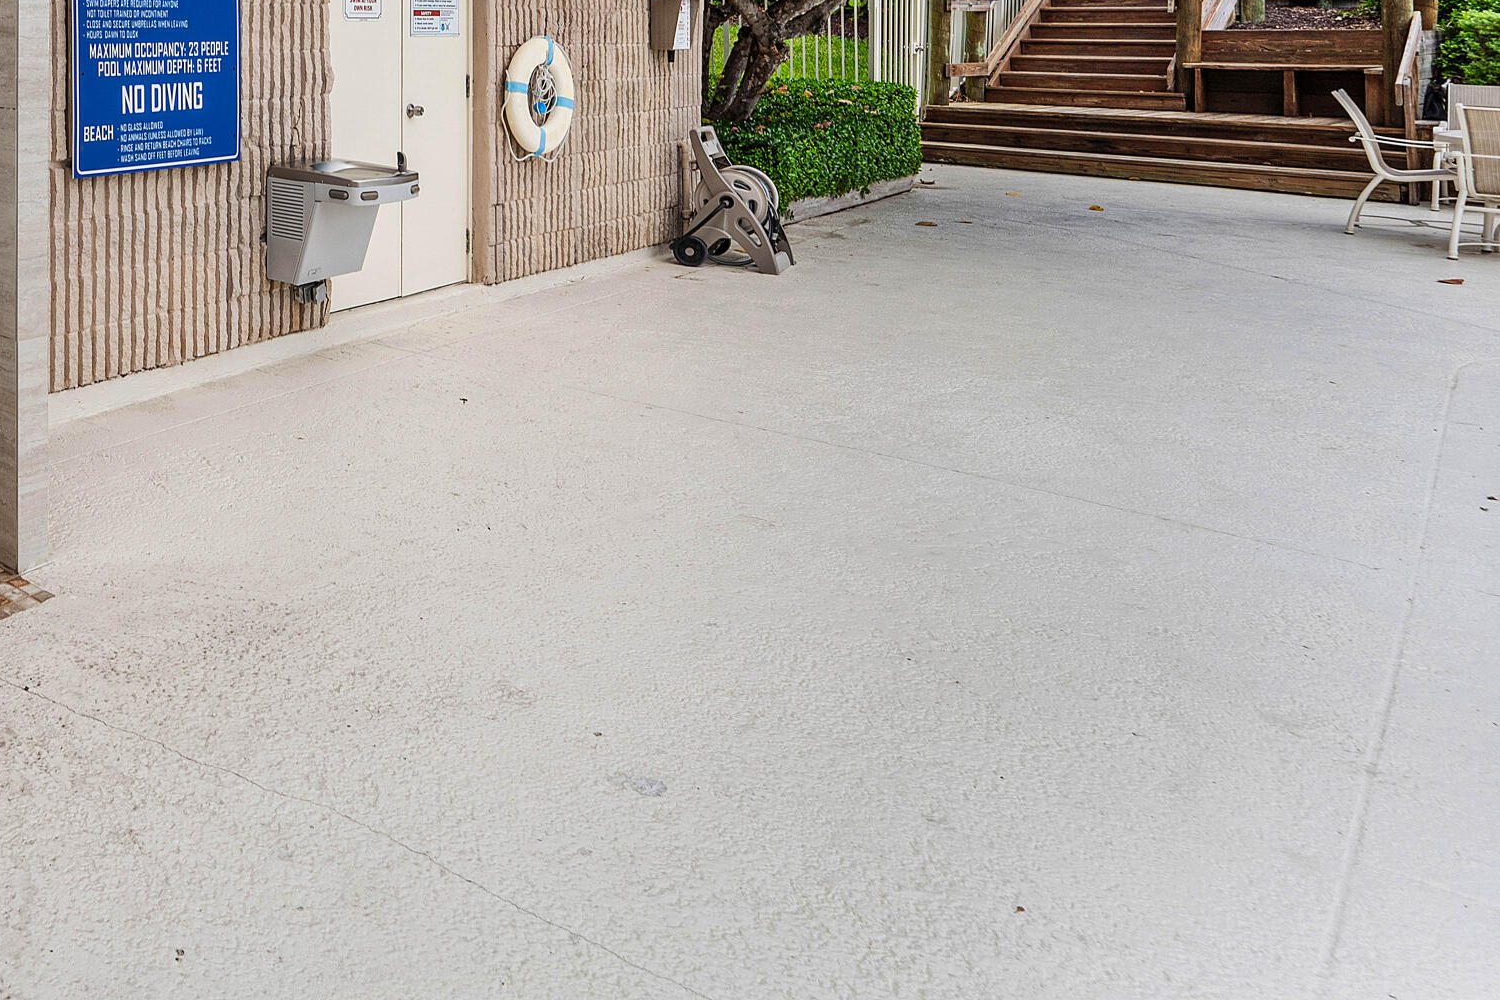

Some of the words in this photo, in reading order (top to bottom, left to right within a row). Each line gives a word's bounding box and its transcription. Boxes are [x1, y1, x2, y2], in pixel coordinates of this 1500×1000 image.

[90, 43, 131, 59] MAXIMUM
[135, 42, 186, 58] OCCUPANCY:
[189, 42, 198, 56] 23
[201, 42, 228, 56] PEOPLE
[98, 61, 121, 77] POOL
[124, 60, 164, 76] MAXIMUM
[167, 59, 194, 74] DEPTH:
[197, 59, 202, 73] 6
[205, 58, 221, 73] FEET
[122, 84, 144, 114] NO
[152, 82, 203, 112] DIVING
[84, 125, 113, 142] BEACH
[128, 123, 142, 131] GLASS
[143, 121, 163, 130] ALLOWED
[128, 133, 147, 142] ANIMALS
[148, 131, 166, 140] (UNLESS
[168, 130, 186, 139] ALLOWED
[121, 144, 133, 152] RINSE
[135, 143, 143, 151] AND
[145, 141, 161, 150] RETURN
[163, 140, 176, 149] BEACH
[177, 138, 192, 147] CHAIRS
[193, 138, 198, 146] TO
[199, 137, 212, 146] RACKS
[121, 154, 134, 162] WASH
[135, 153, 146, 161] SAND
[157, 151, 166, 159] FEET
[168, 149, 182, 158] BEFORE
[184, 148, 199, 157] LEAVING
